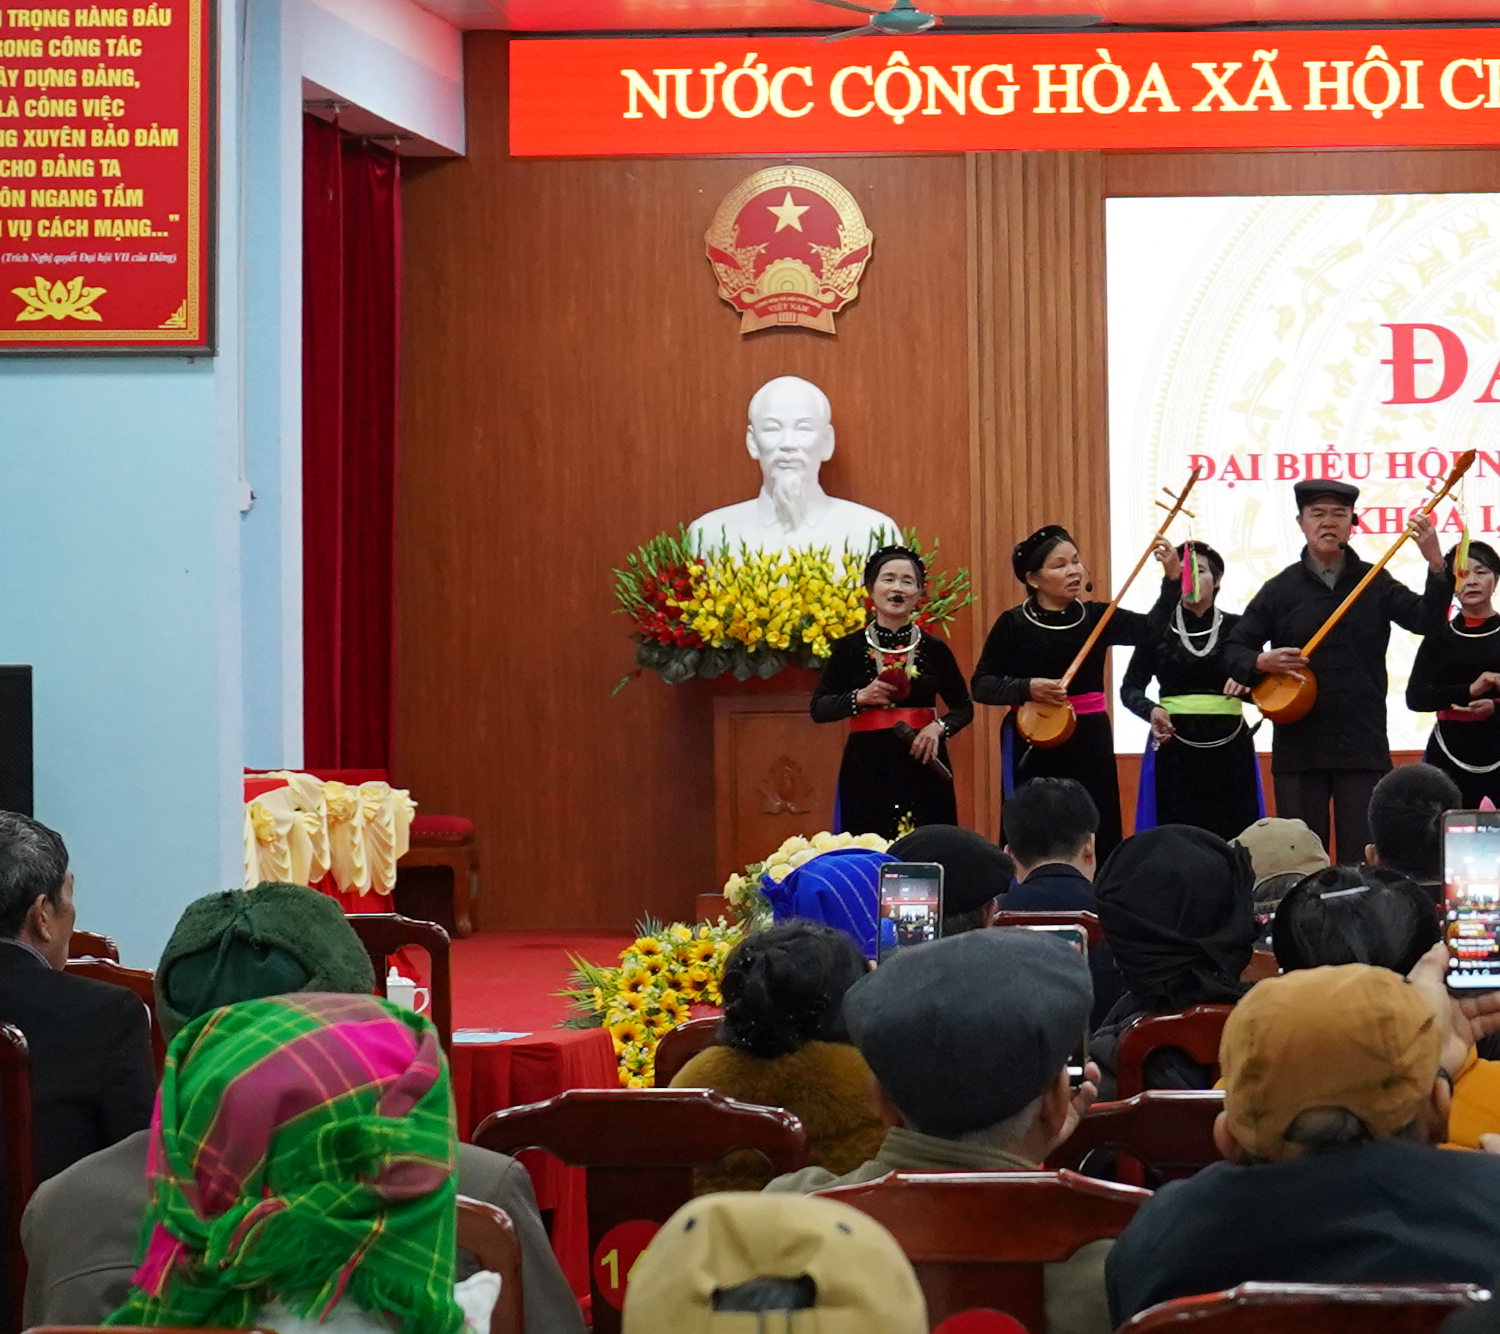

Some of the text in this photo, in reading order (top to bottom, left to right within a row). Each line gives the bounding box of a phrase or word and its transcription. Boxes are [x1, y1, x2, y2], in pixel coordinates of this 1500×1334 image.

[48, 36, 101, 57] CÔNG
[106, 35, 142, 57] TÁC
[621, 53, 814, 119] NƯỚC
[830, 50, 1020, 124] CỘNG
[1033, 48, 1180, 114] HÒA
[1192, 48, 1292, 111] XÃ
[1303, 44, 1424, 119] HỘI
[25, 96, 77, 117] CÔNG
[82, 95, 124, 120] VIỆC
[42, 155, 94, 177] ĐẢNG
[99, 159, 121, 177] TA
[8, 220, 32, 241] VỤ
[38, 216, 88, 237] CÁCH
[1189, 454, 1261, 489] ĐẠI
[1276, 445, 1371, 481] BIỂU
